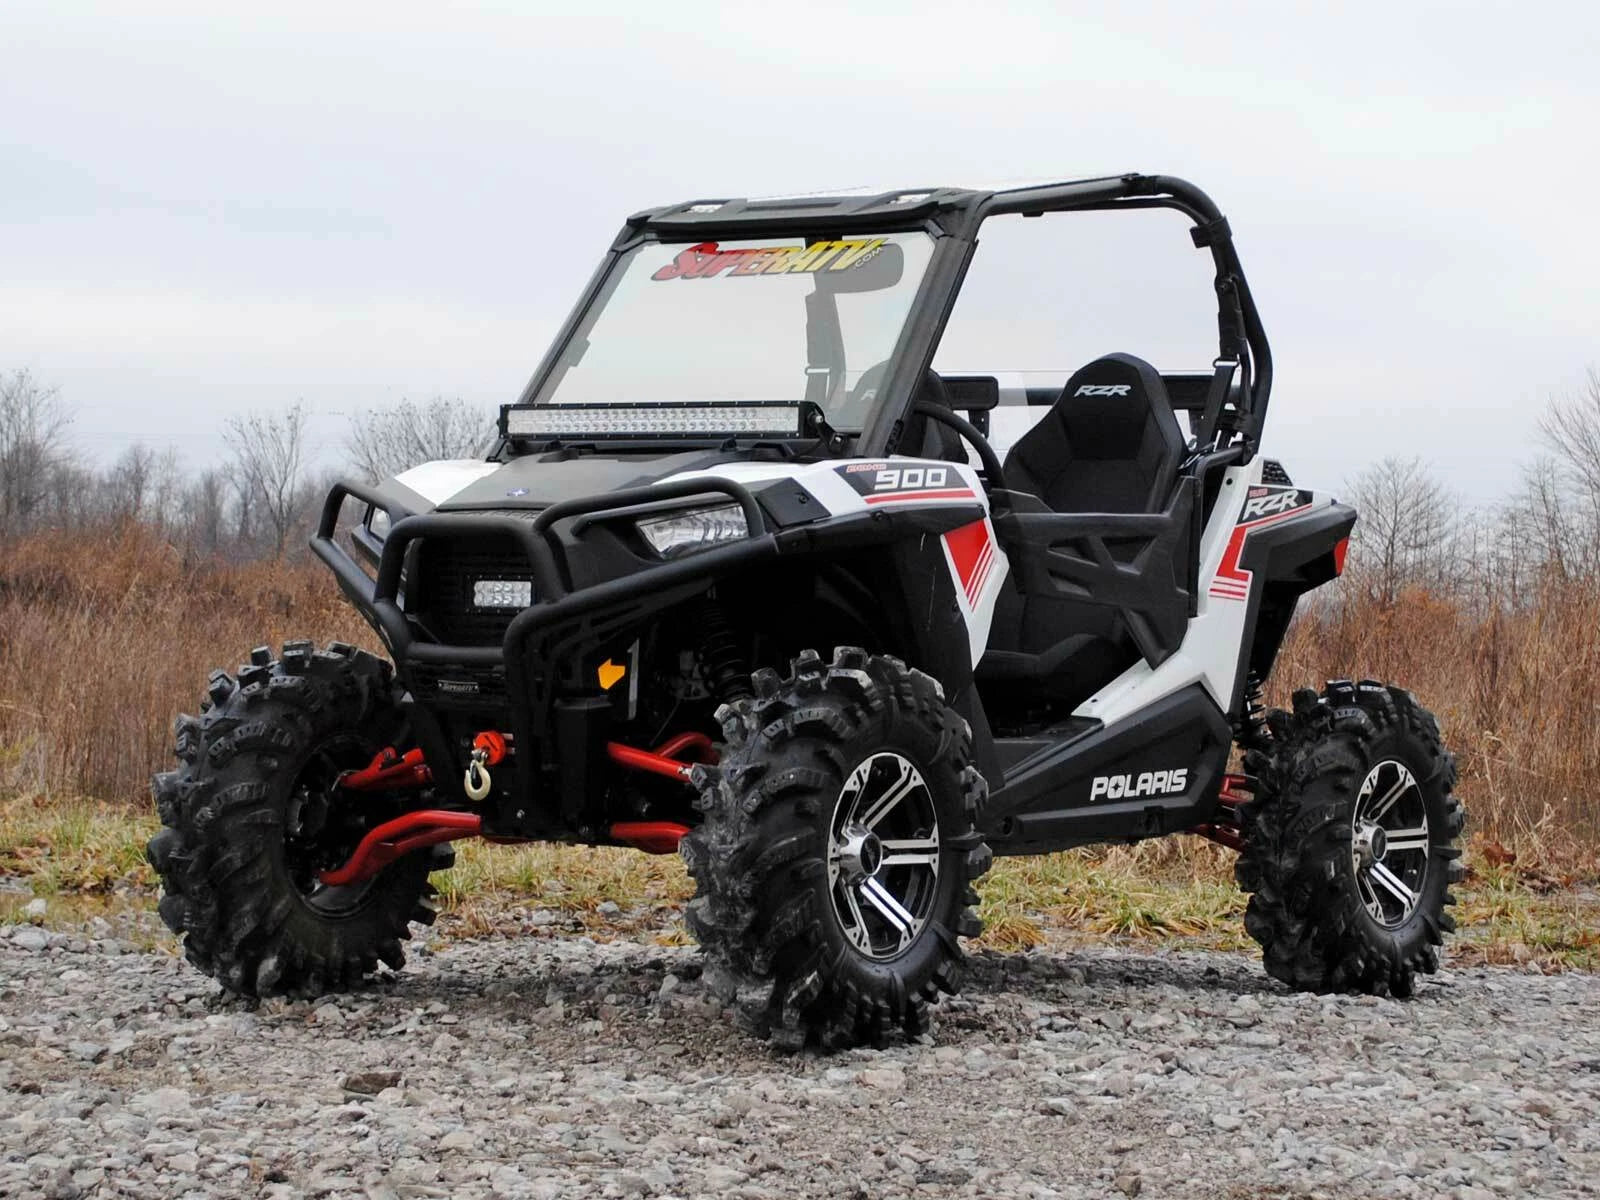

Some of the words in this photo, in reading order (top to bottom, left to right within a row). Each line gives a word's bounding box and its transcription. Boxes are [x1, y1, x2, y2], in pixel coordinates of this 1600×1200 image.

[651, 238, 888, 281] SUPERATV
[1073, 385, 1132, 398] RZR
[874, 468, 948, 491] 900
[1242, 490, 1299, 521] RZR
[1090, 768, 1188, 801] POLARIS
